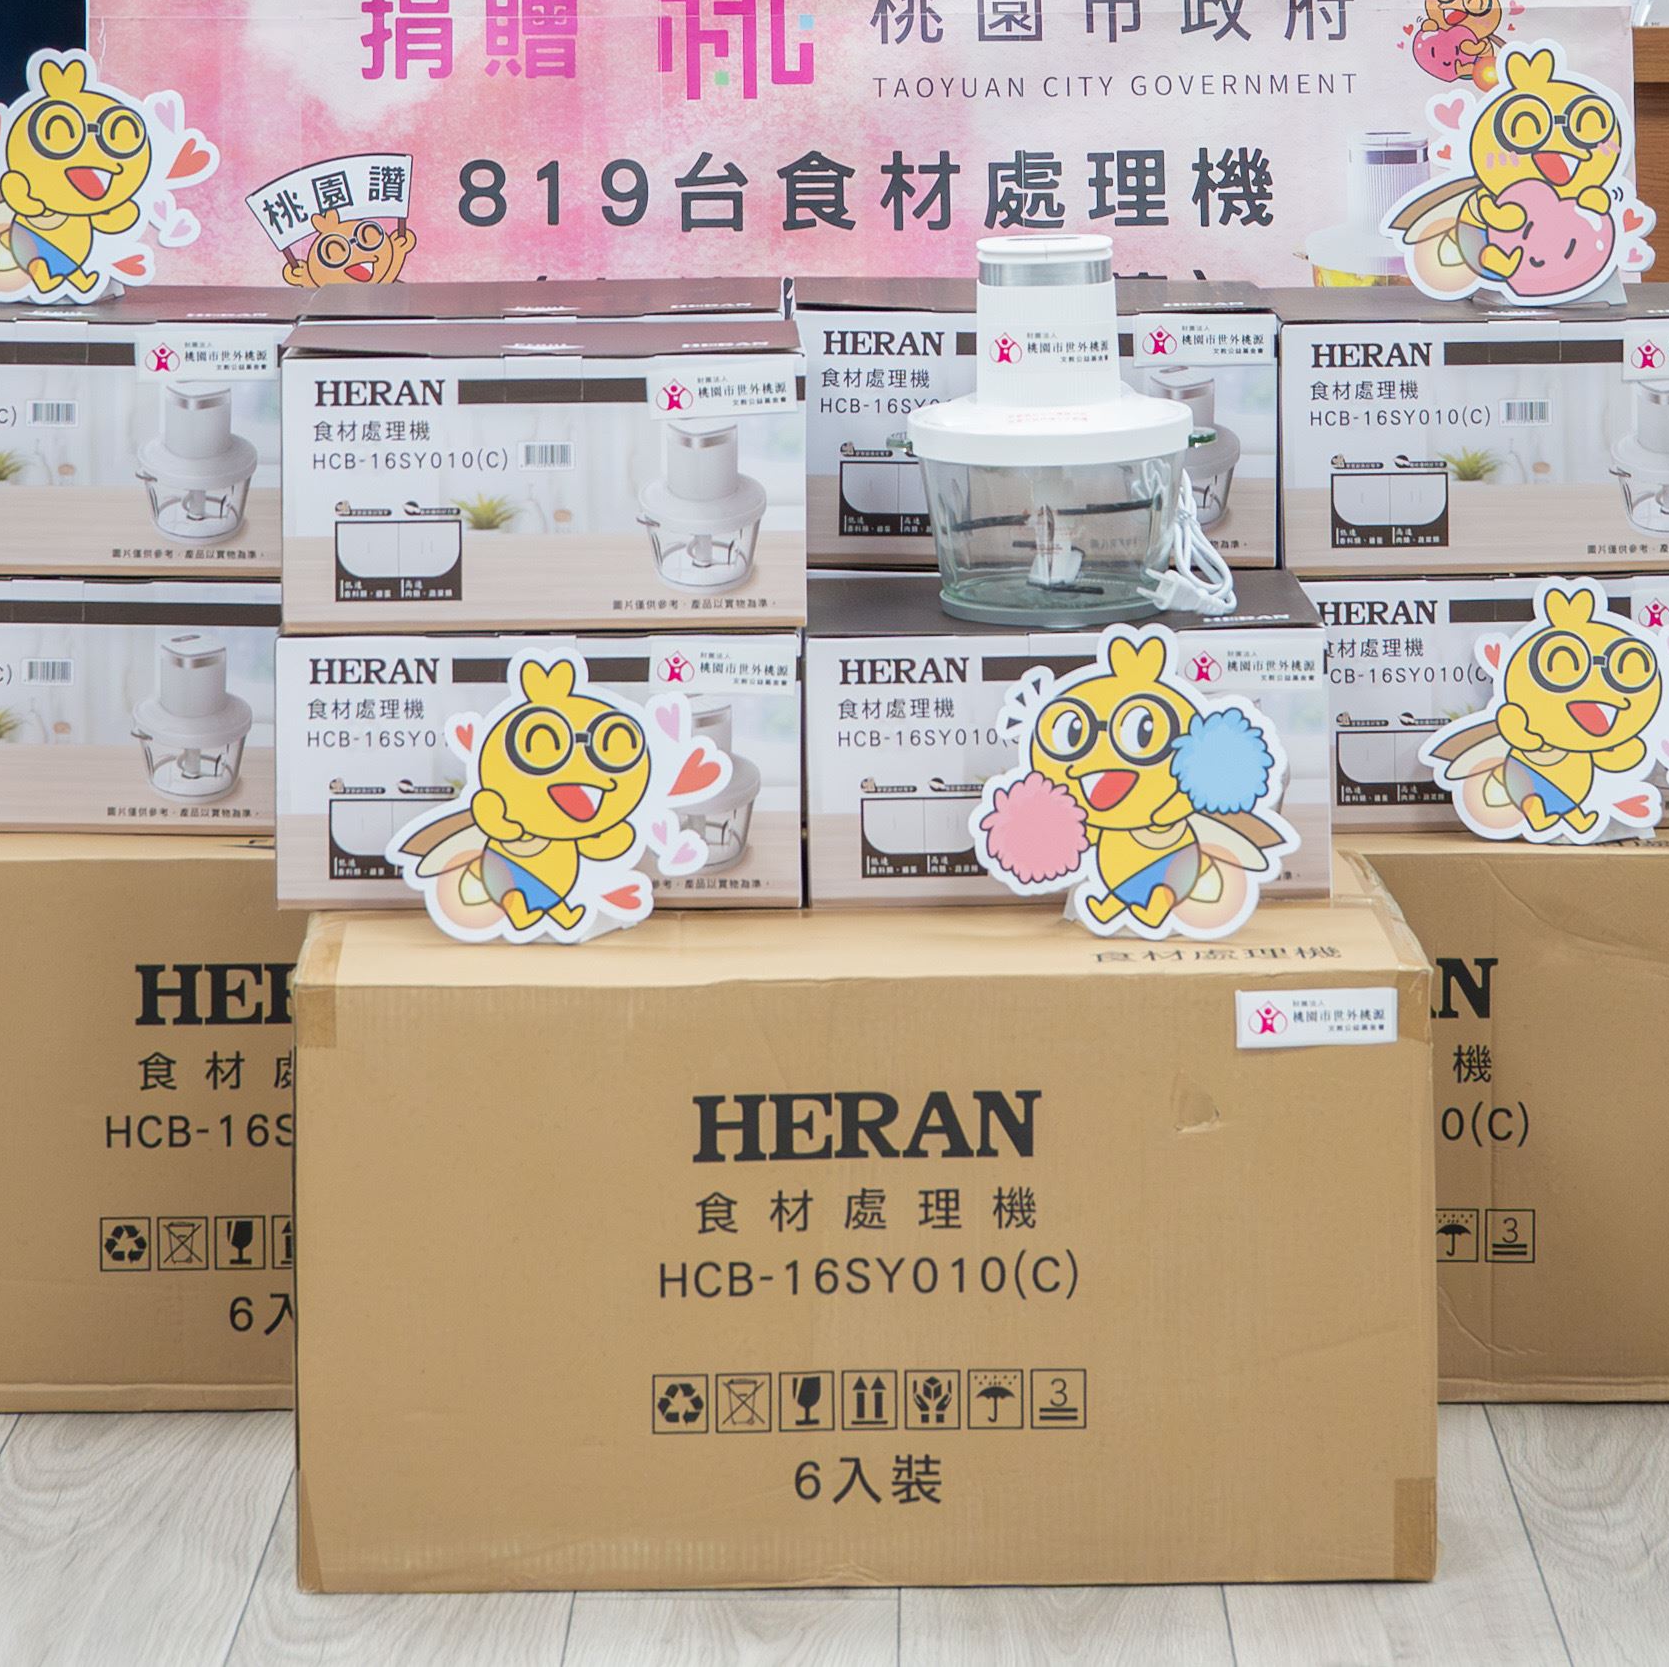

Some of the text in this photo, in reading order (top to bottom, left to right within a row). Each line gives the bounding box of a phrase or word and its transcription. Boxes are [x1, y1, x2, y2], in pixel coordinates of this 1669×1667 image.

[872, 72, 1360, 99] TAOYUAN CITY GOVERNMENT
[457, 147, 1277, 234] 819台食材處理機
[823, 330, 945, 356] HERAN
[1311, 342, 1433, 368] HERAN
[821, 367, 931, 389] 食材處理機
[1310, 379, 1419, 401] 食材處理機
[314, 379, 446, 407] HERAN
[820, 397, 952, 415] HCB-16SY
[1310, 405, 1491, 428] HCB-16SY010(C)
[313, 419, 431, 443] 食材處理機
[312, 448, 509, 471] HCB-16SY010(C)
[1316, 600, 1438, 626] HERAN
[309, 657, 441, 685] HERAN
[838, 657, 970, 685] HERAN
[1329, 663, 1494, 685] CB-16SY010(C
[307, 698, 425, 720] 食材處理機
[838, 697, 955, 720] 食材處理機
[307, 730, 449, 748] HCB-16SY0
[838, 728, 1020, 748] HCB-16SY010
[692, 1089, 1043, 1163] HERAN
[694, 1185, 1038, 1235] 食材處理機
[658, 1248, 1079, 1301] HCB-16SY010(C)
[792, 1453, 943, 1505] 6入裝
